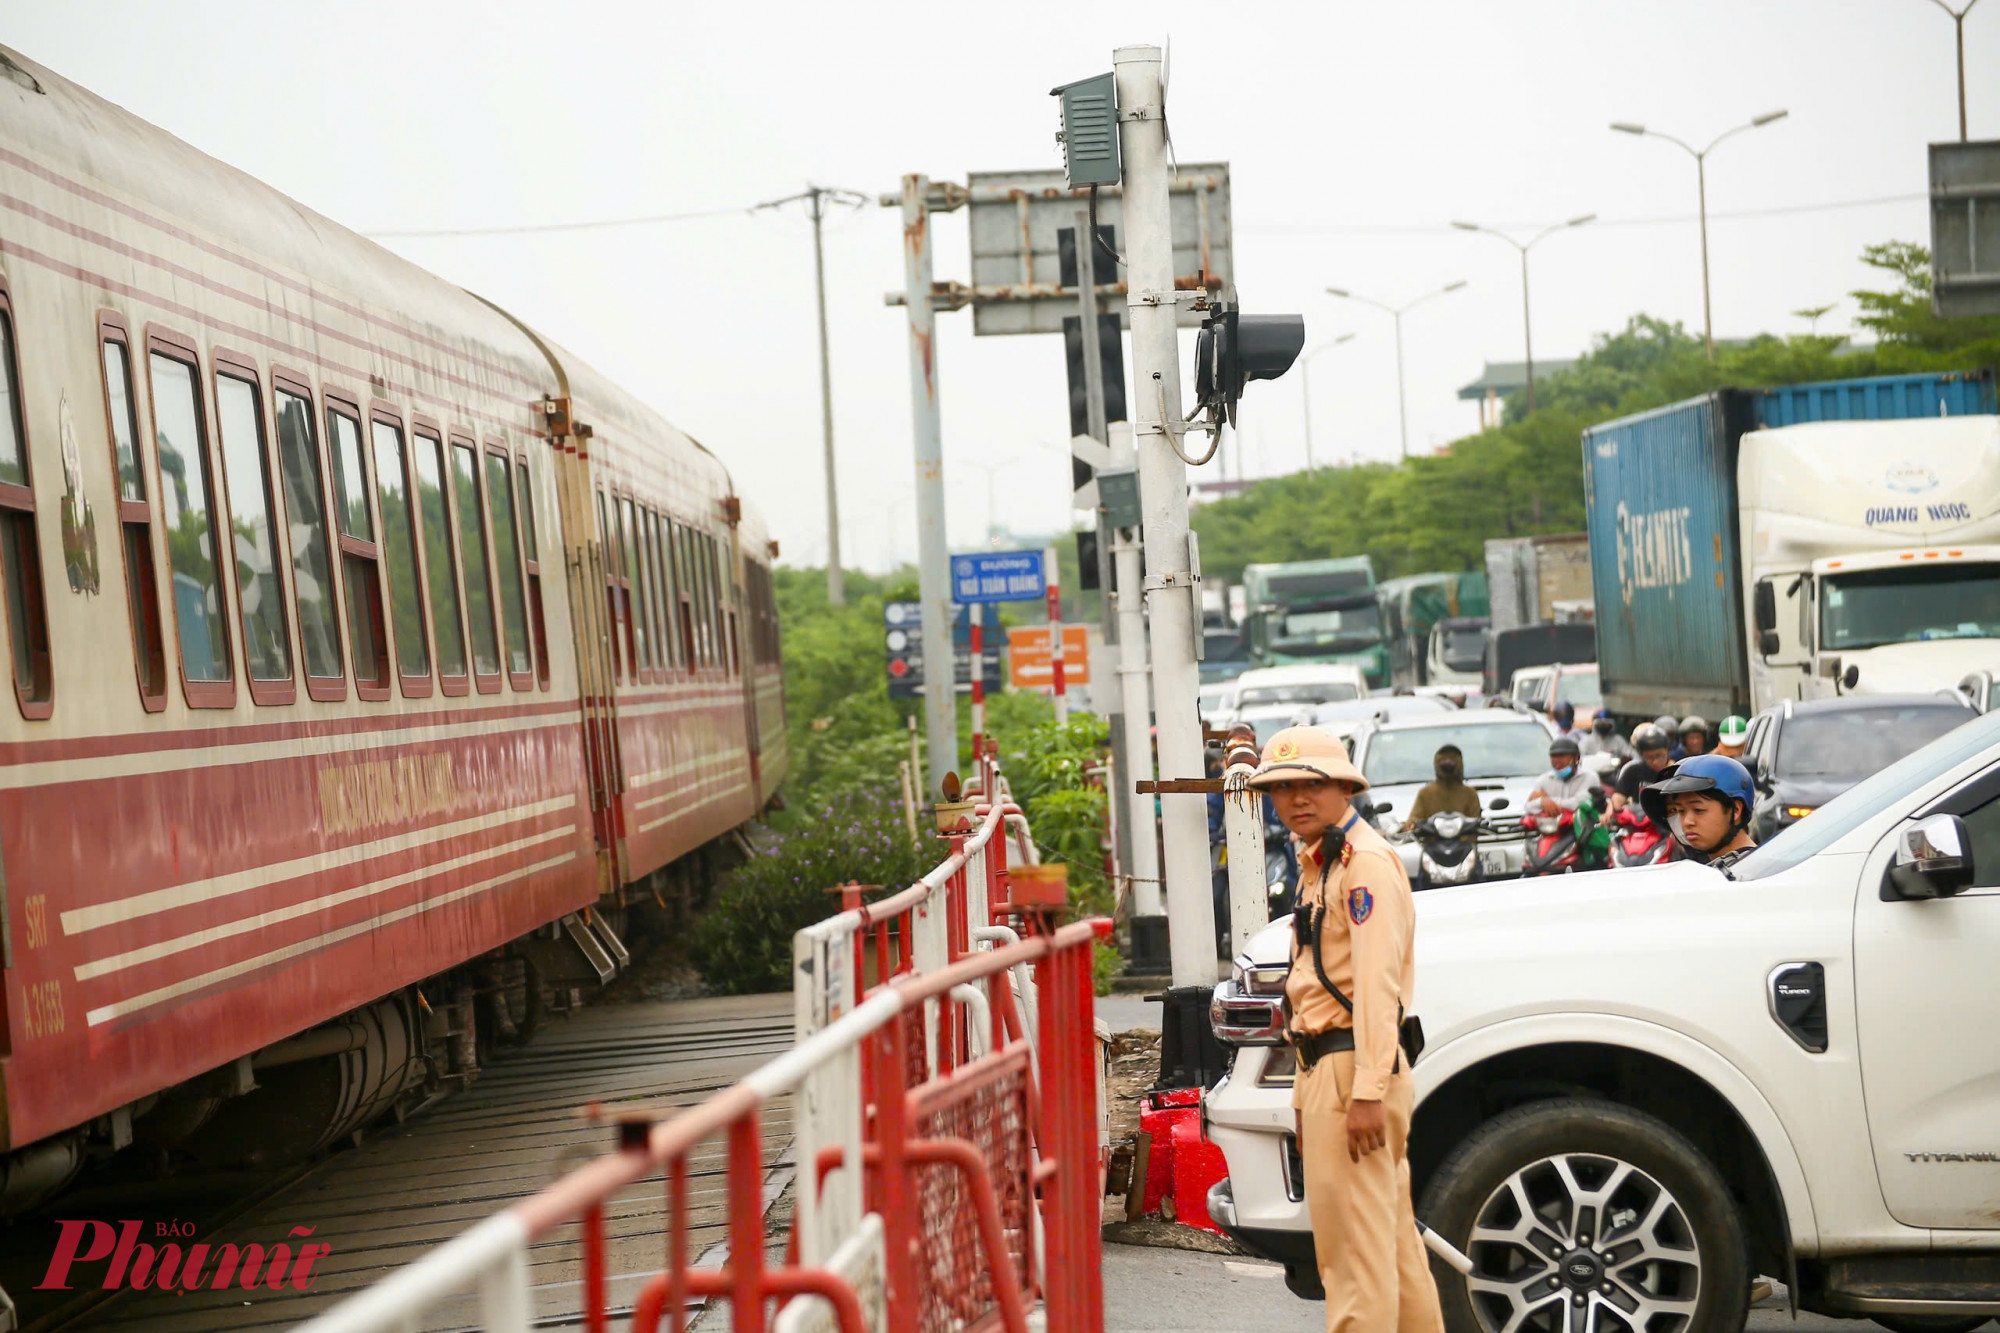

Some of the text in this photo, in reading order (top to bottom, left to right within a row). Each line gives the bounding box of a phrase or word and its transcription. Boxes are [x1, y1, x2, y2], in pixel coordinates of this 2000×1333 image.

[1865, 501, 1971, 527] QUANG NGỌC
[25, 893, 48, 951] SRT
[22, 984, 35, 1041] A
